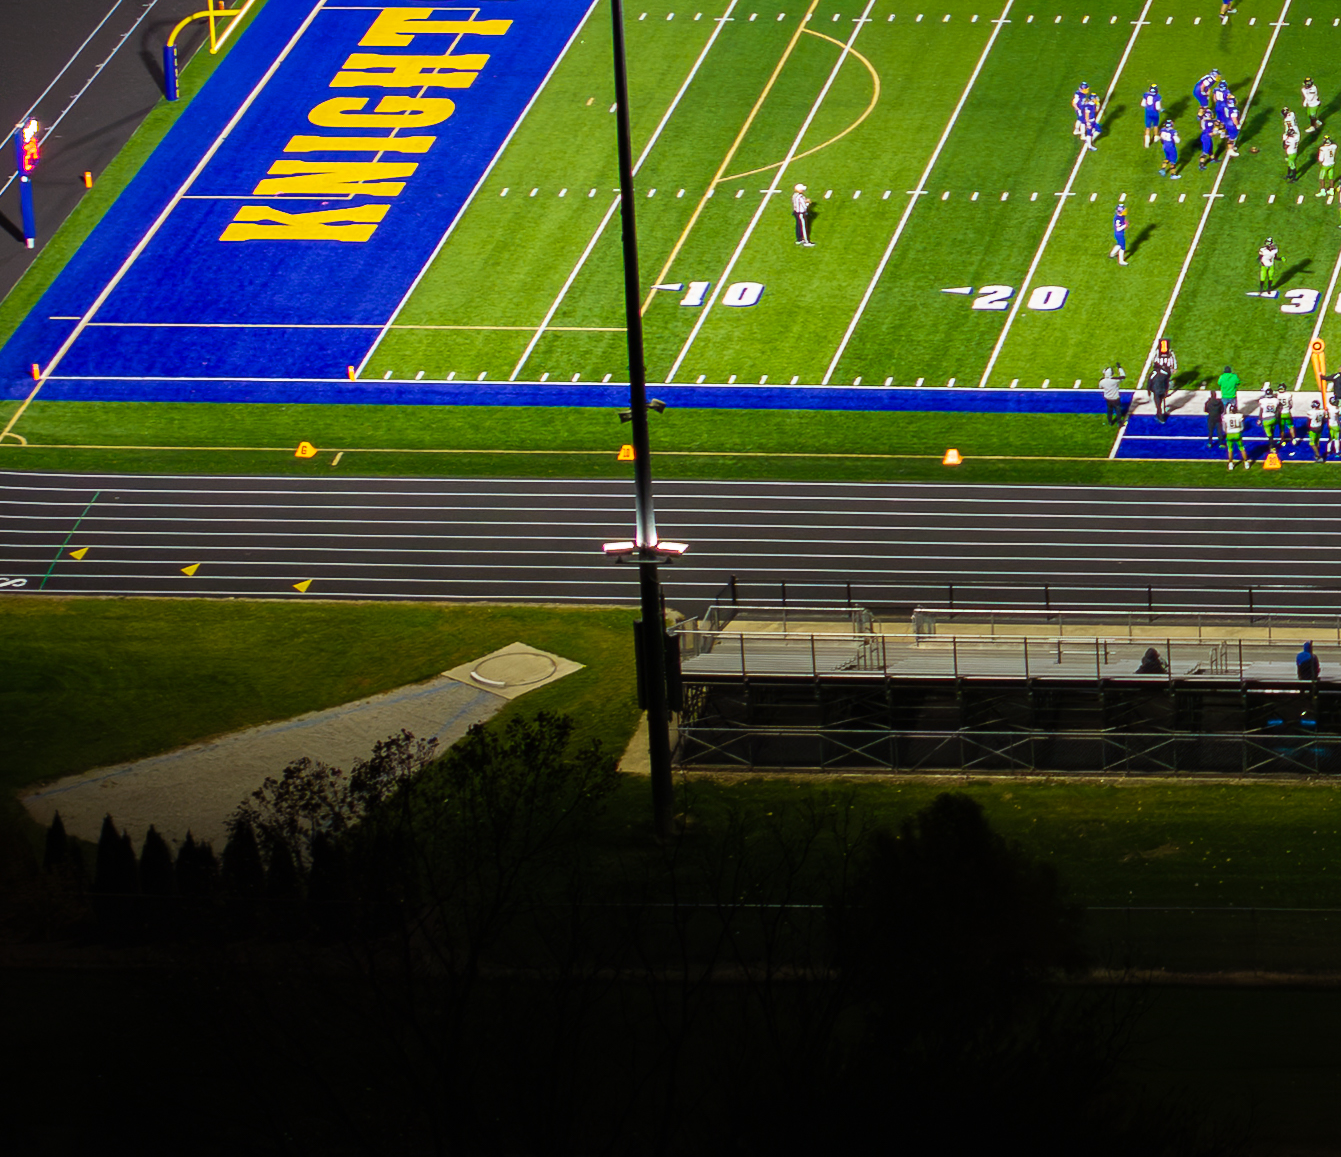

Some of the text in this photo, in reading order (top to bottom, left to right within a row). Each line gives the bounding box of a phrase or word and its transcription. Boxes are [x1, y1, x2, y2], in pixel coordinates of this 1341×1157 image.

[677, 280, 765, 308] 10
[970, 284, 1070, 312] 20
[1160, 340, 1168, 353] 1
